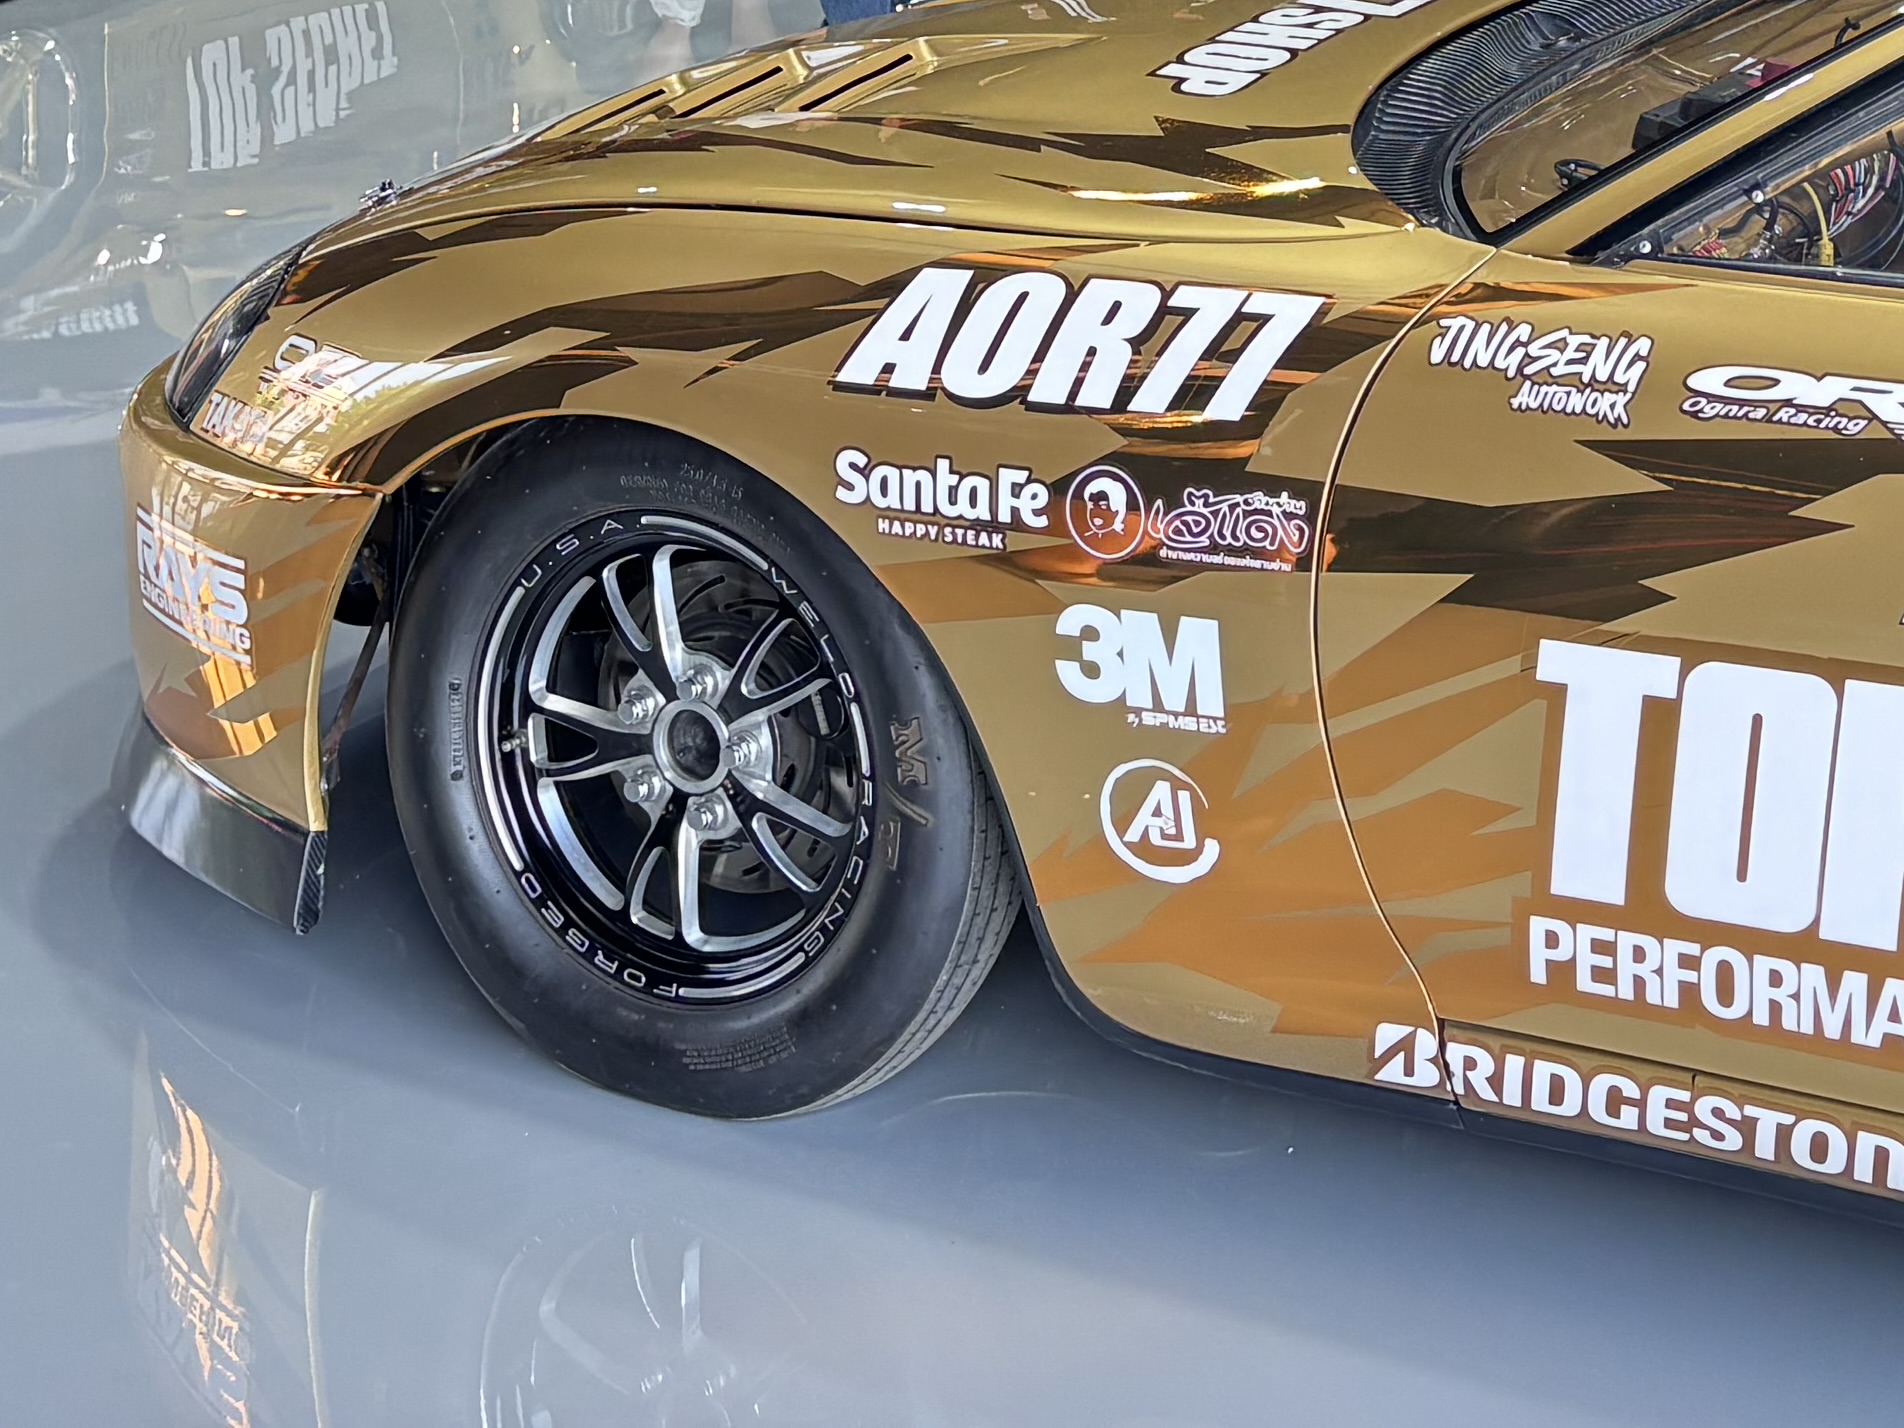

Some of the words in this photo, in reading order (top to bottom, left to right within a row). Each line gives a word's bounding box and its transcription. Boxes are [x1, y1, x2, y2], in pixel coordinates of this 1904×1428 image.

[835, 266, 1326, 424] AOR77
[1429, 315, 1652, 394] JINGSENG
[1772, 406, 1869, 435] Racing
[136, 520, 249, 626] RAYS
[877, 518, 940, 543] HAPPY
[943, 525, 1005, 552] STEAK
[772, 565, 857, 701] WELD
[1053, 602, 1226, 719] 3M
[808, 778, 875, 958] RACING
[520, 869, 680, 1001] FORGED
